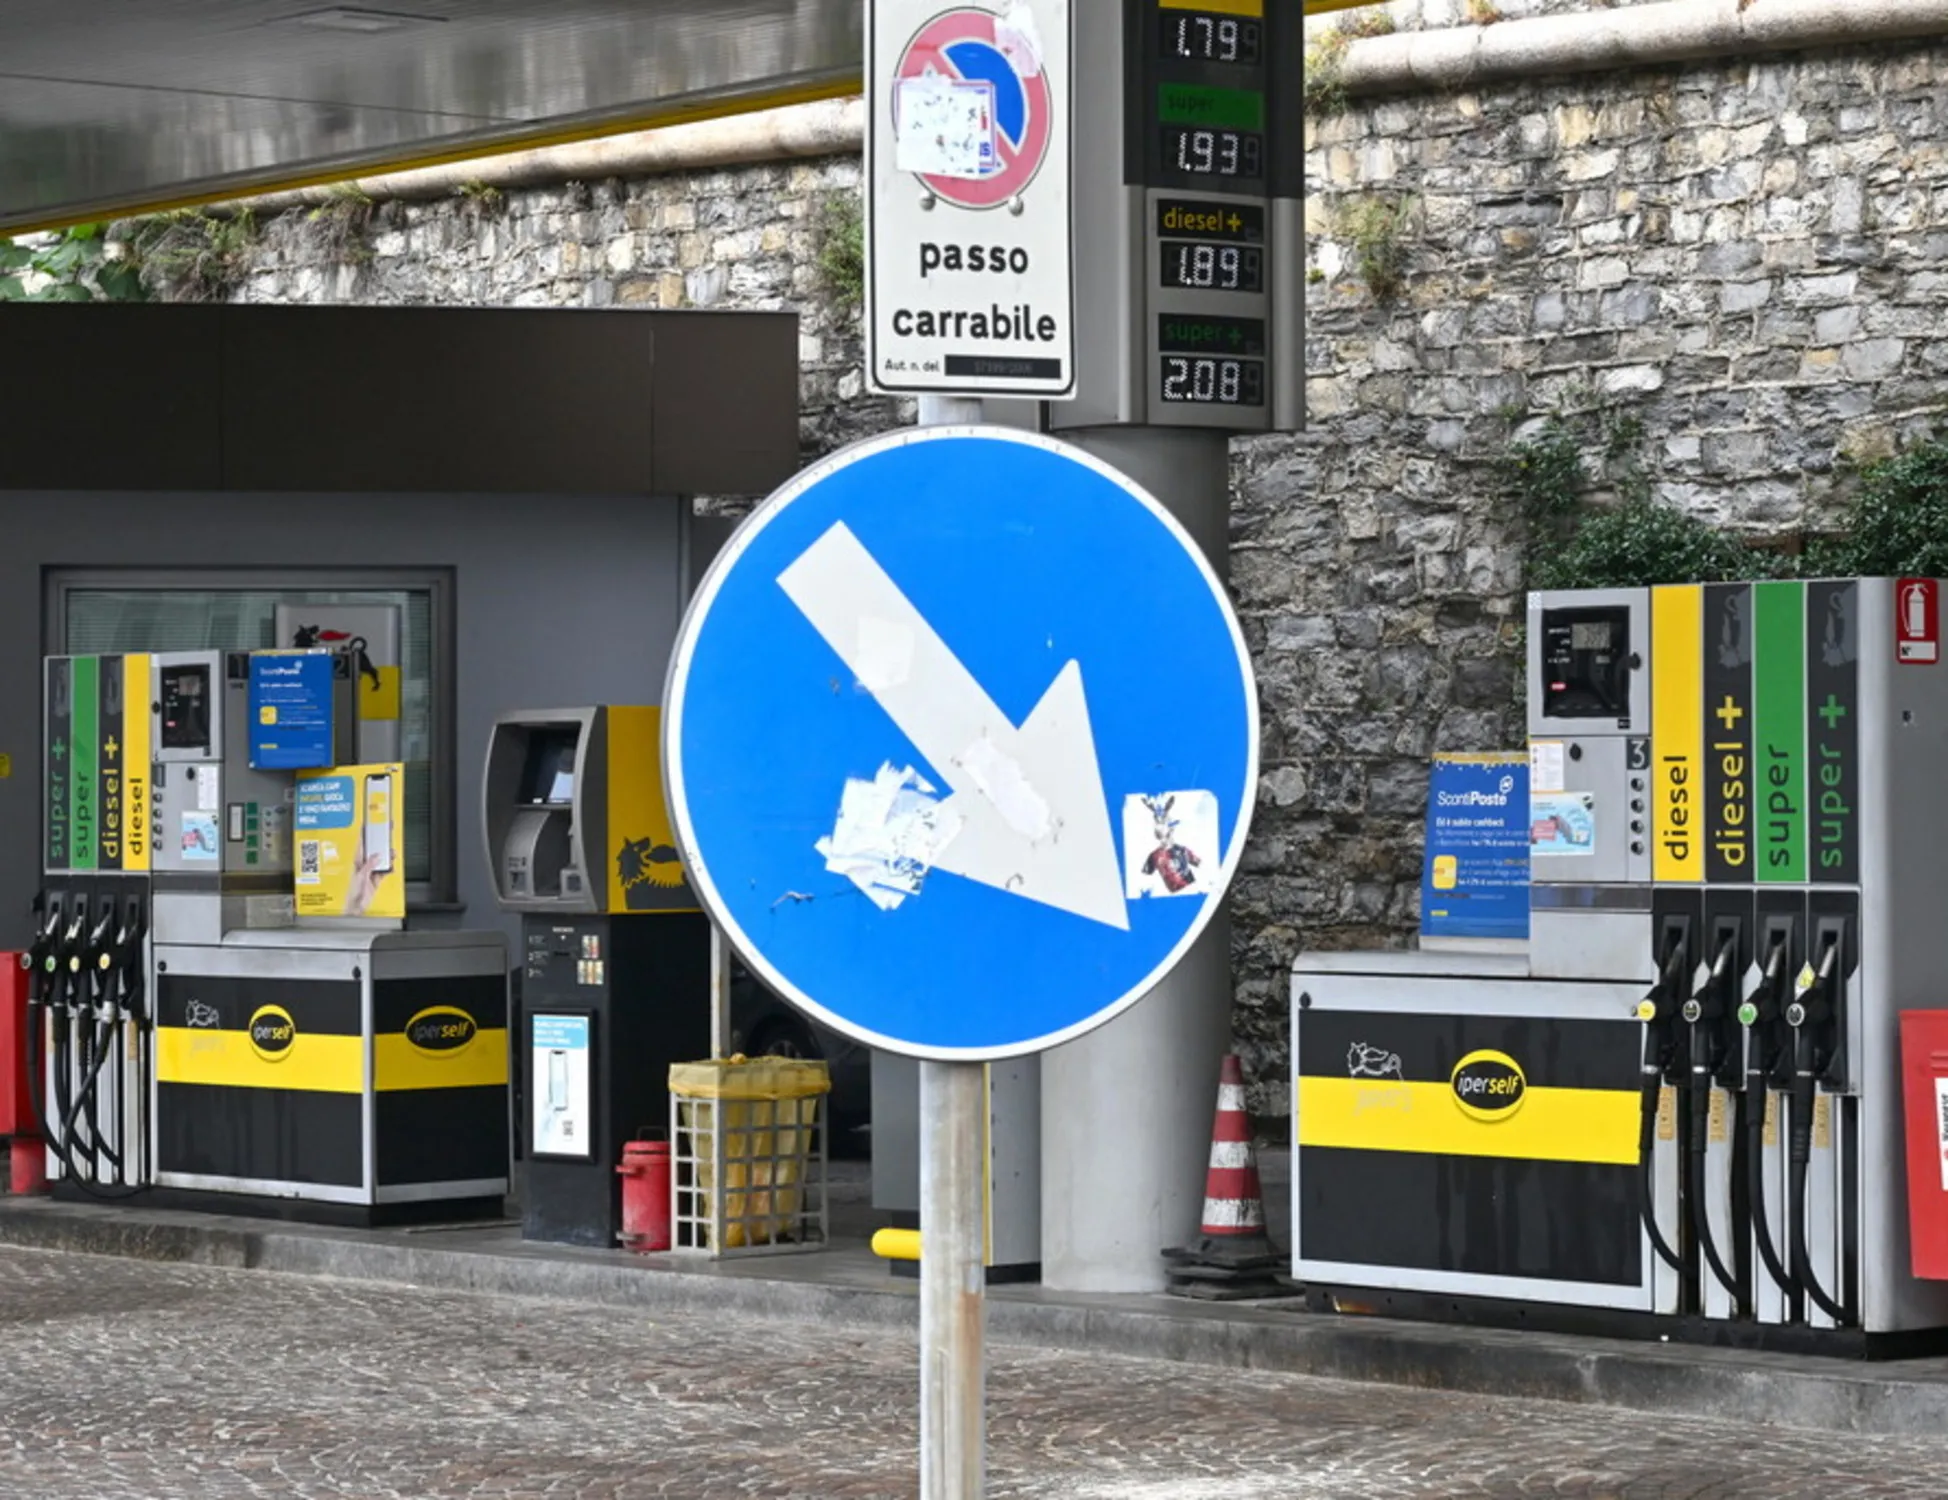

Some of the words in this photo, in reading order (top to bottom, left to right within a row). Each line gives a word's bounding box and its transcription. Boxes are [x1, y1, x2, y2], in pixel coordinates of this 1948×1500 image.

[1168, 95, 1214, 114] super
[919, 242, 1029, 278] passo
[892, 303, 1057, 342] carrabile
[1164, 322, 1222, 346] super
[1630, 740, 1646, 768] 3
[50, 770, 68, 858] super
[77, 771, 92, 859] super
[102, 769, 119, 858] diesel
[129, 778, 143, 855] diesel
[1437, 790, 1508, 806] ScontiPoste
[1663, 756, 1689, 861] diesel
[1714, 743, 1745, 866] diesel
[1768, 744, 1797, 867] super
[1820, 743, 1849, 868] super
[253, 1021, 292, 1042] iperself
[414, 1022, 468, 1042] iperself
[1458, 1072, 1519, 1097] iperself
